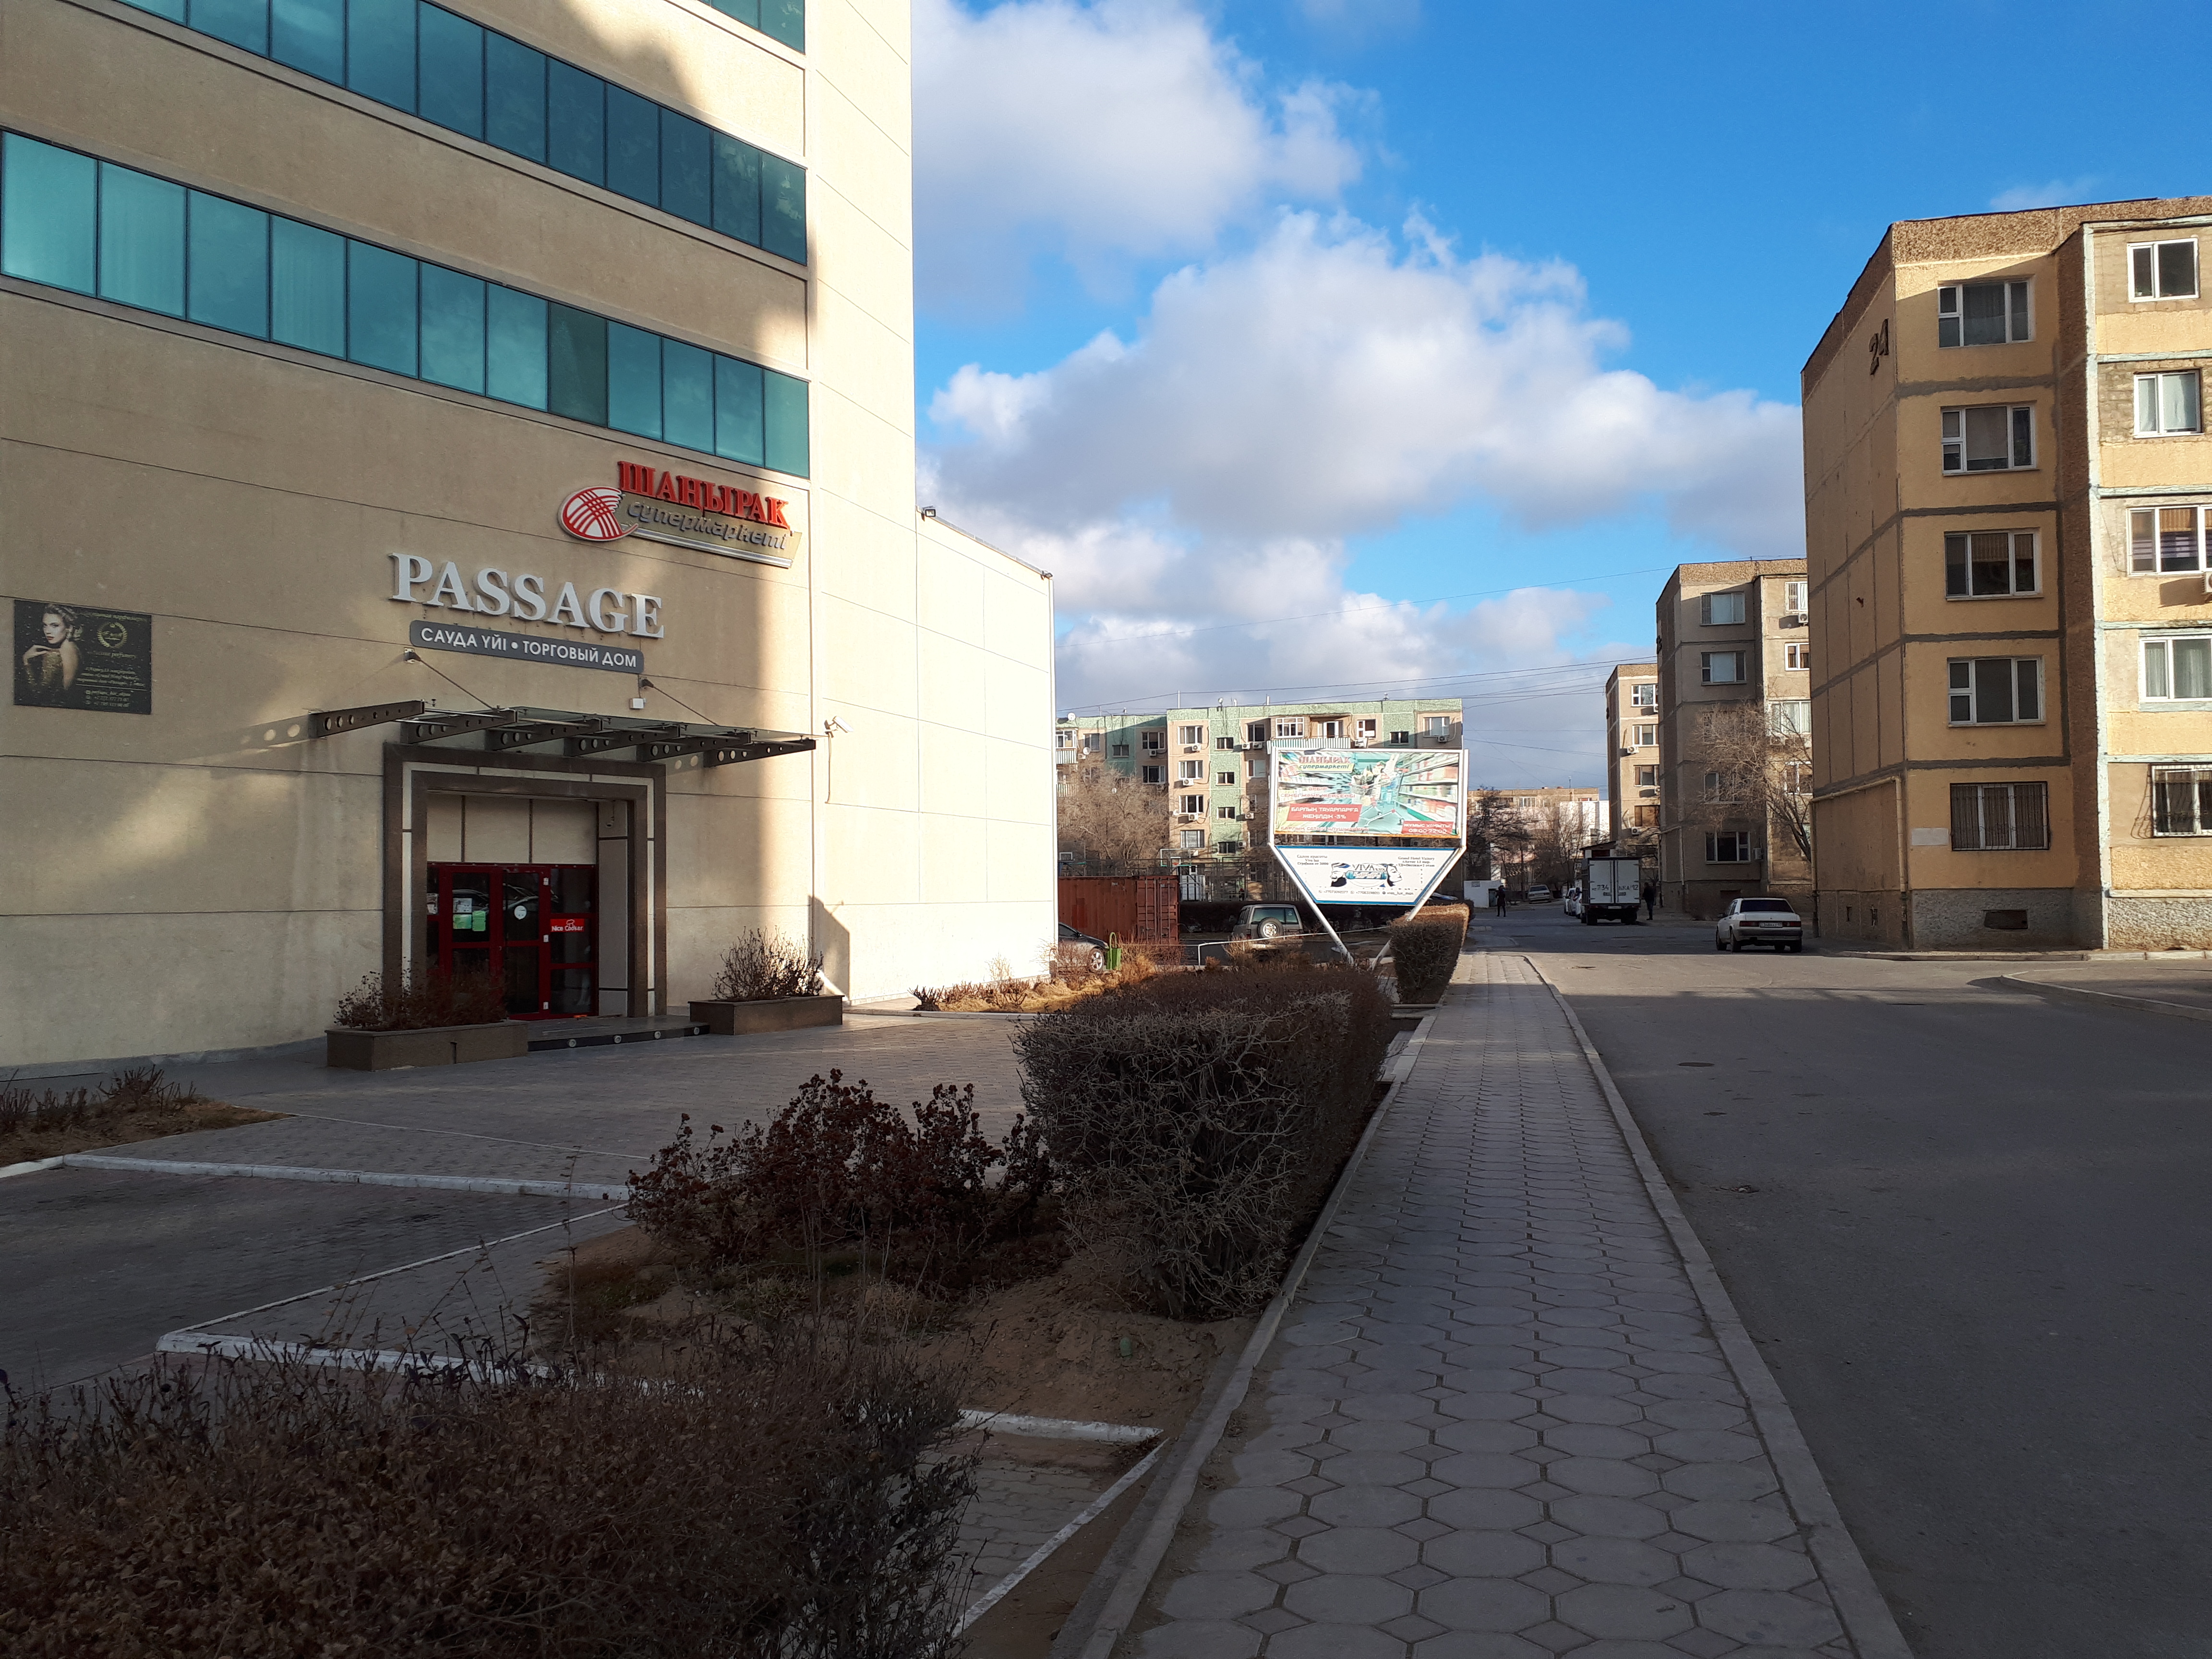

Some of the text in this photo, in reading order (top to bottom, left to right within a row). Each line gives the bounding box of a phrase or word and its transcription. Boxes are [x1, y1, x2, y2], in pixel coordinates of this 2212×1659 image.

[1869, 318, 1889, 375] 24
[628, 501, 787, 550] супермаркеті
[388, 552, 664, 639] PASSAGE
[421, 627, 637, 668] САУДА ҮЙІ ТОРГОВЫЙ ДОМ
